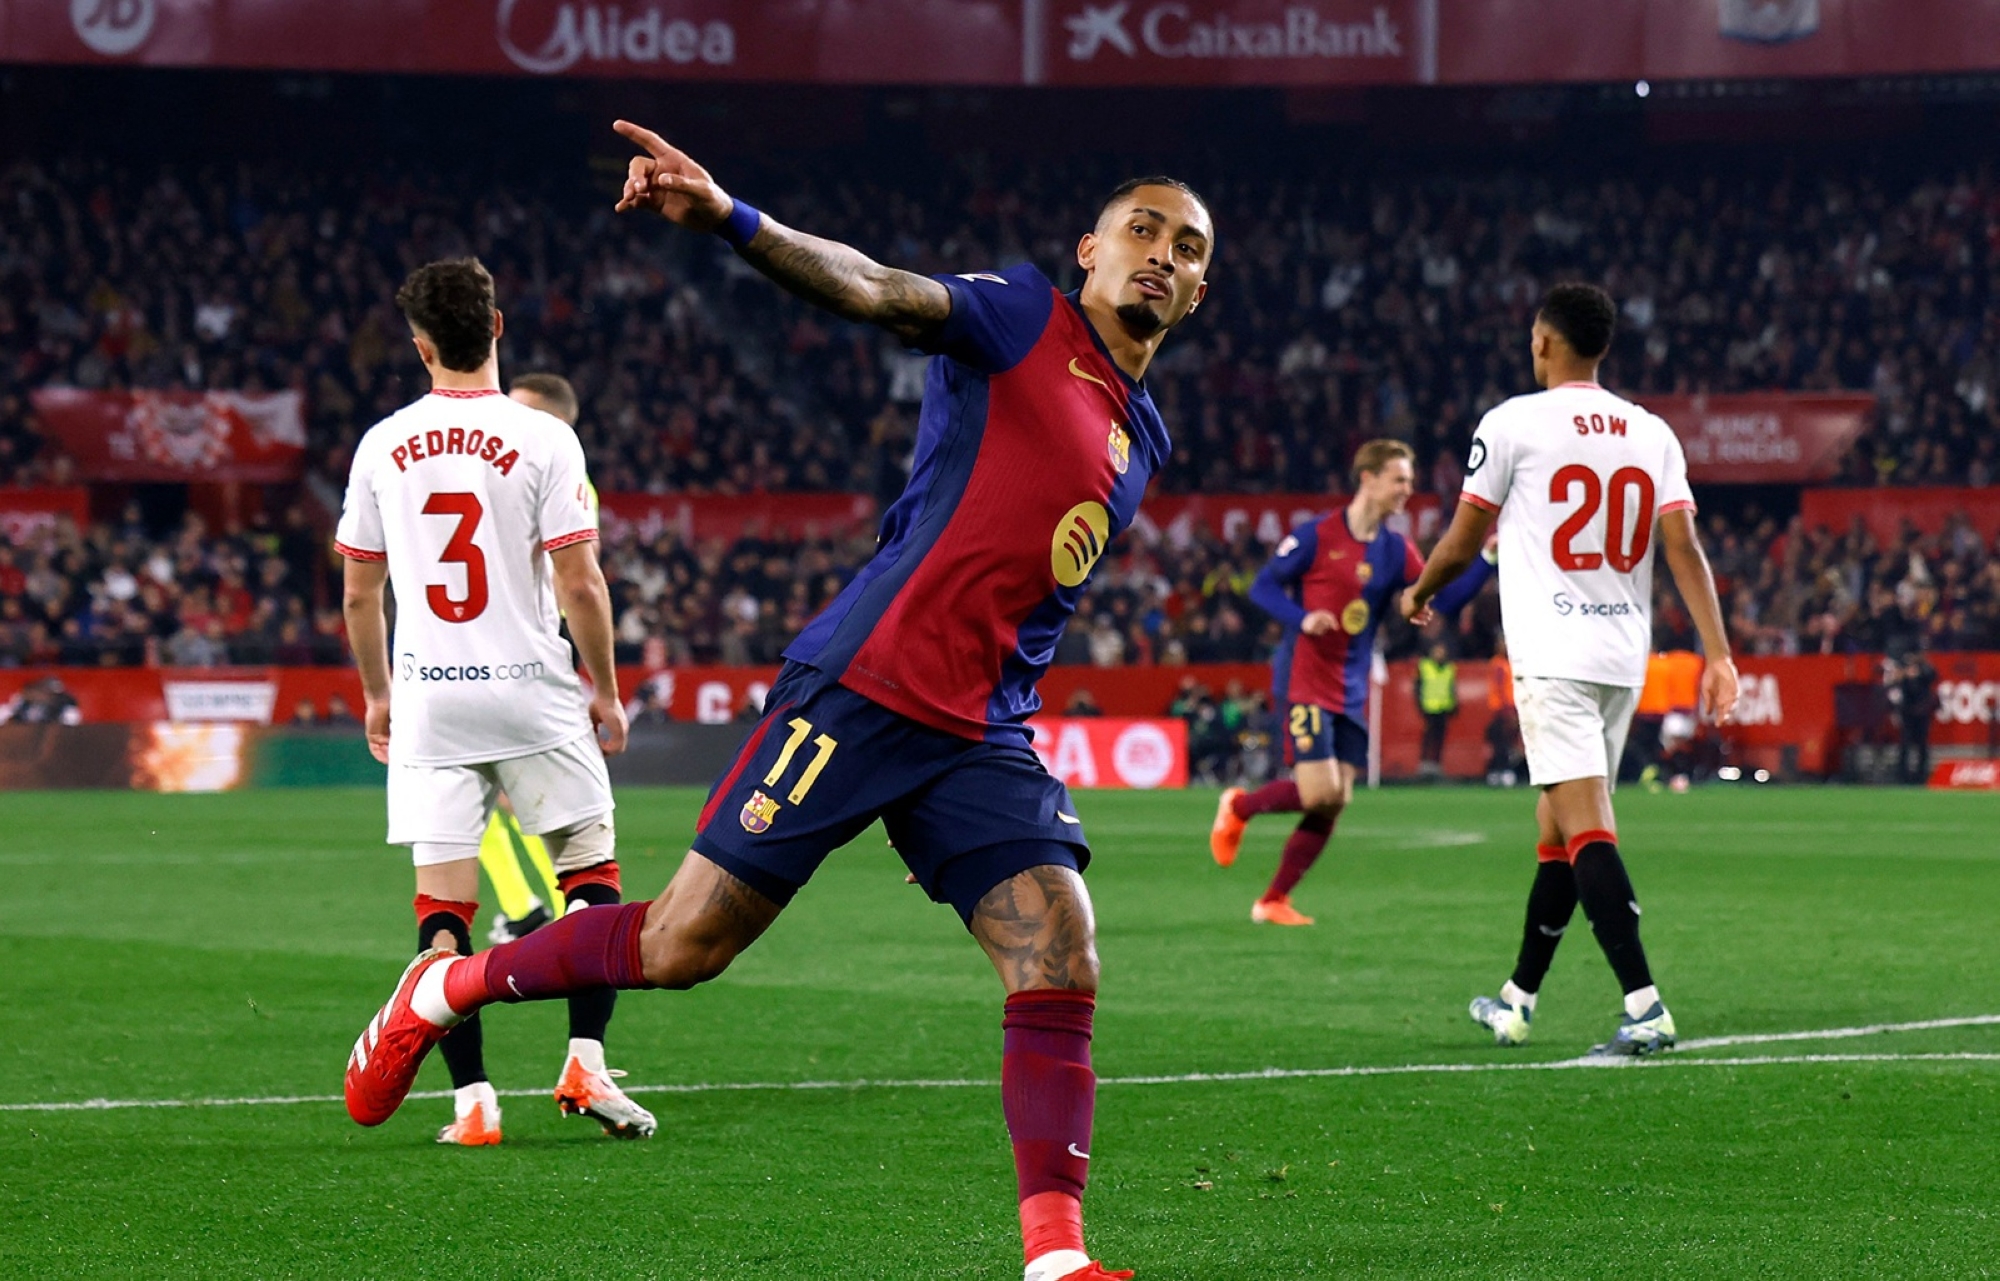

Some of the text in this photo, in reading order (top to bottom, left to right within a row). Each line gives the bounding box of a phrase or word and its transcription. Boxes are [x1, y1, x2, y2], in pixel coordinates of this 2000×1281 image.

[497, 0, 736, 73] Midea
[1142, 6, 1402, 58] CaixaBank
[390, 428, 520, 477] PEDROSA
[1573, 414, 1627, 437] SOW
[1550, 464, 1655, 574] 20
[421, 492, 488, 623] 3
[1289, 704, 1322, 736] 21
[762, 717, 838, 806] 11
